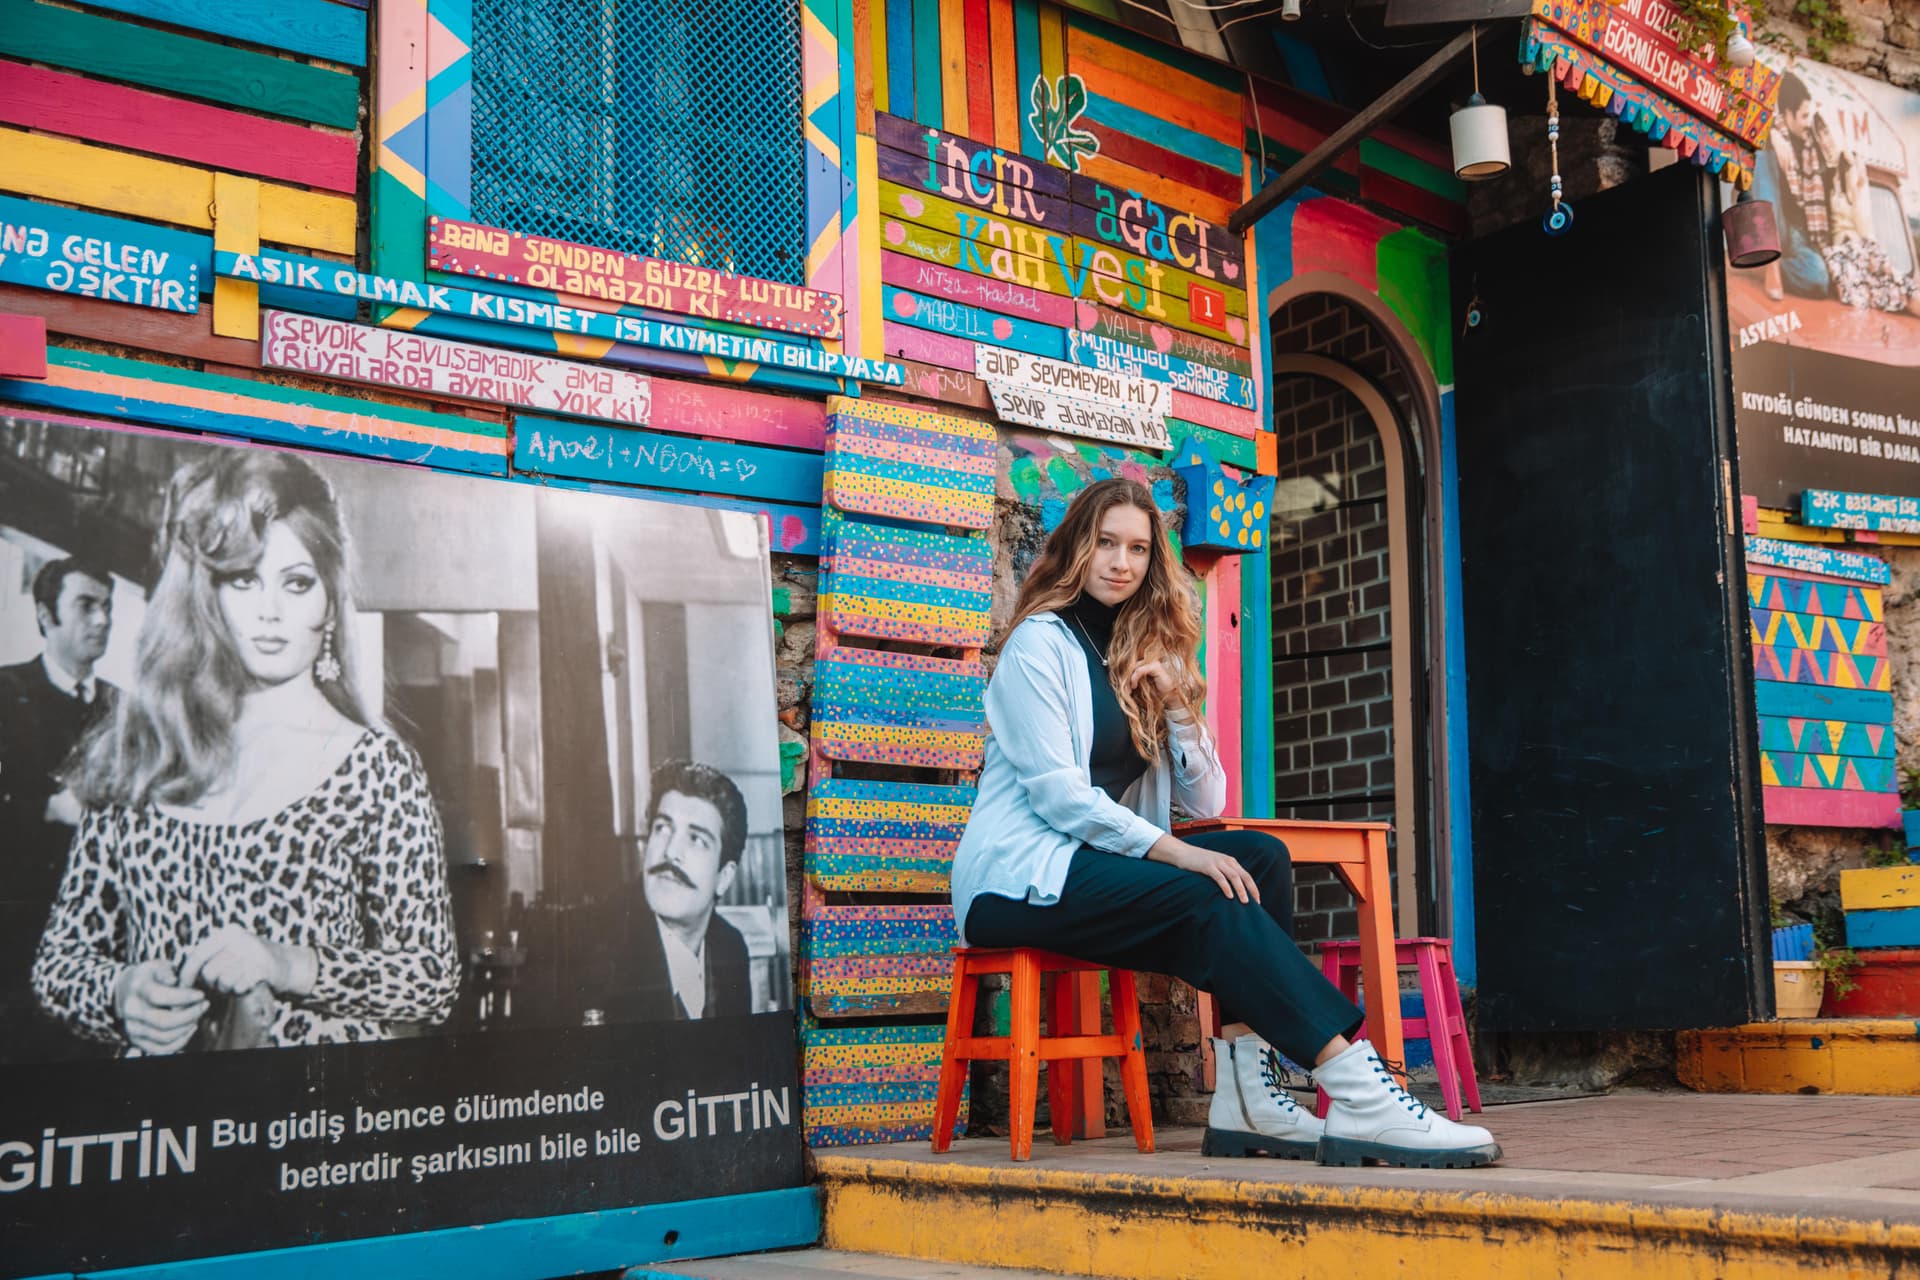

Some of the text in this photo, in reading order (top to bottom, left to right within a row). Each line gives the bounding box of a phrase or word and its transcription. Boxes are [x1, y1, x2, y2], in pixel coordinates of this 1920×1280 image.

[62, 235, 169, 275] GELEN
[334, 270, 451, 311] OLMAK
[470, 292, 597, 333] KISMET
[740, 278, 817, 312] LUTUF
[1203, 295, 1214, 318] 1
[552, 389, 604, 419] YOK
[1794, 397, 1850, 426] GÜNDEN
[1851, 411, 1896, 434] SONRA
[1783, 426, 1858, 455] HATAMIYDI
[211, 1085, 606, 1150] Bu gidiş bence ölümdende
[653, 1082, 791, 1142] GİTTİN
[0, 1119, 198, 1193] GİTTİN
[280, 1126, 642, 1191] beterdir şarkısını bile bile
